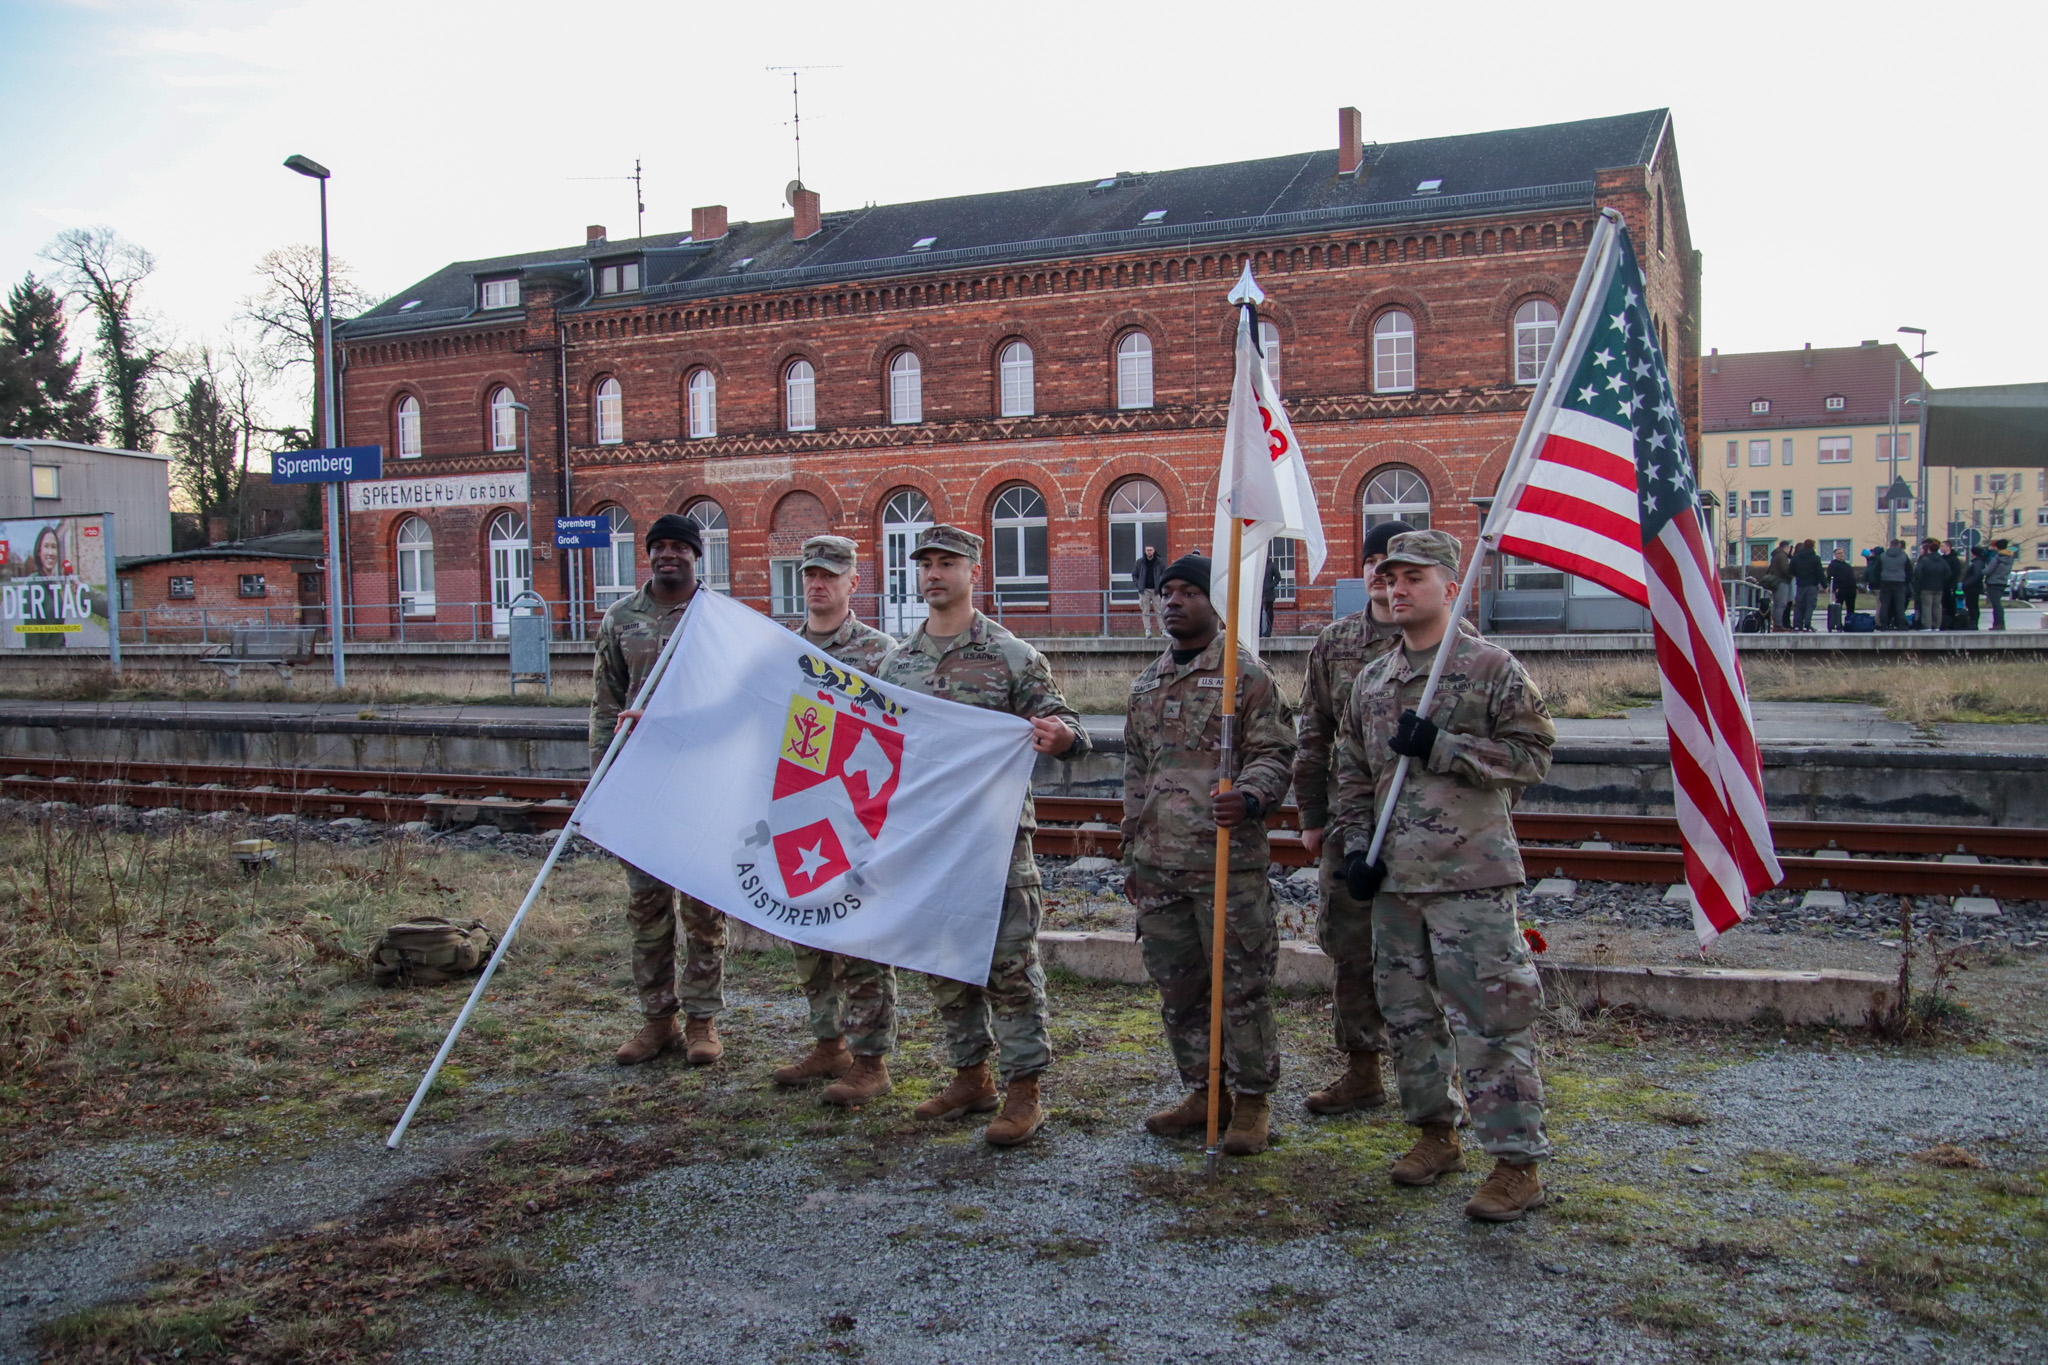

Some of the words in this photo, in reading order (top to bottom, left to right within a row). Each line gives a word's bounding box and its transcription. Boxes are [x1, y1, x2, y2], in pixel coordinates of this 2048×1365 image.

[277, 454, 353, 478] Spremberg
[362, 483, 454, 506] SPREMBERG
[557, 518, 596, 531] Spremberg
[557, 535, 580, 545] Grodk
[2, 584, 46, 620] DER
[48, 583, 92, 619] TAG
[44, 624, 82, 632] BRANDENBURG
[1452, 681, 1477, 691] ARMY
[736, 862, 862, 927] ASISTIREMOS
